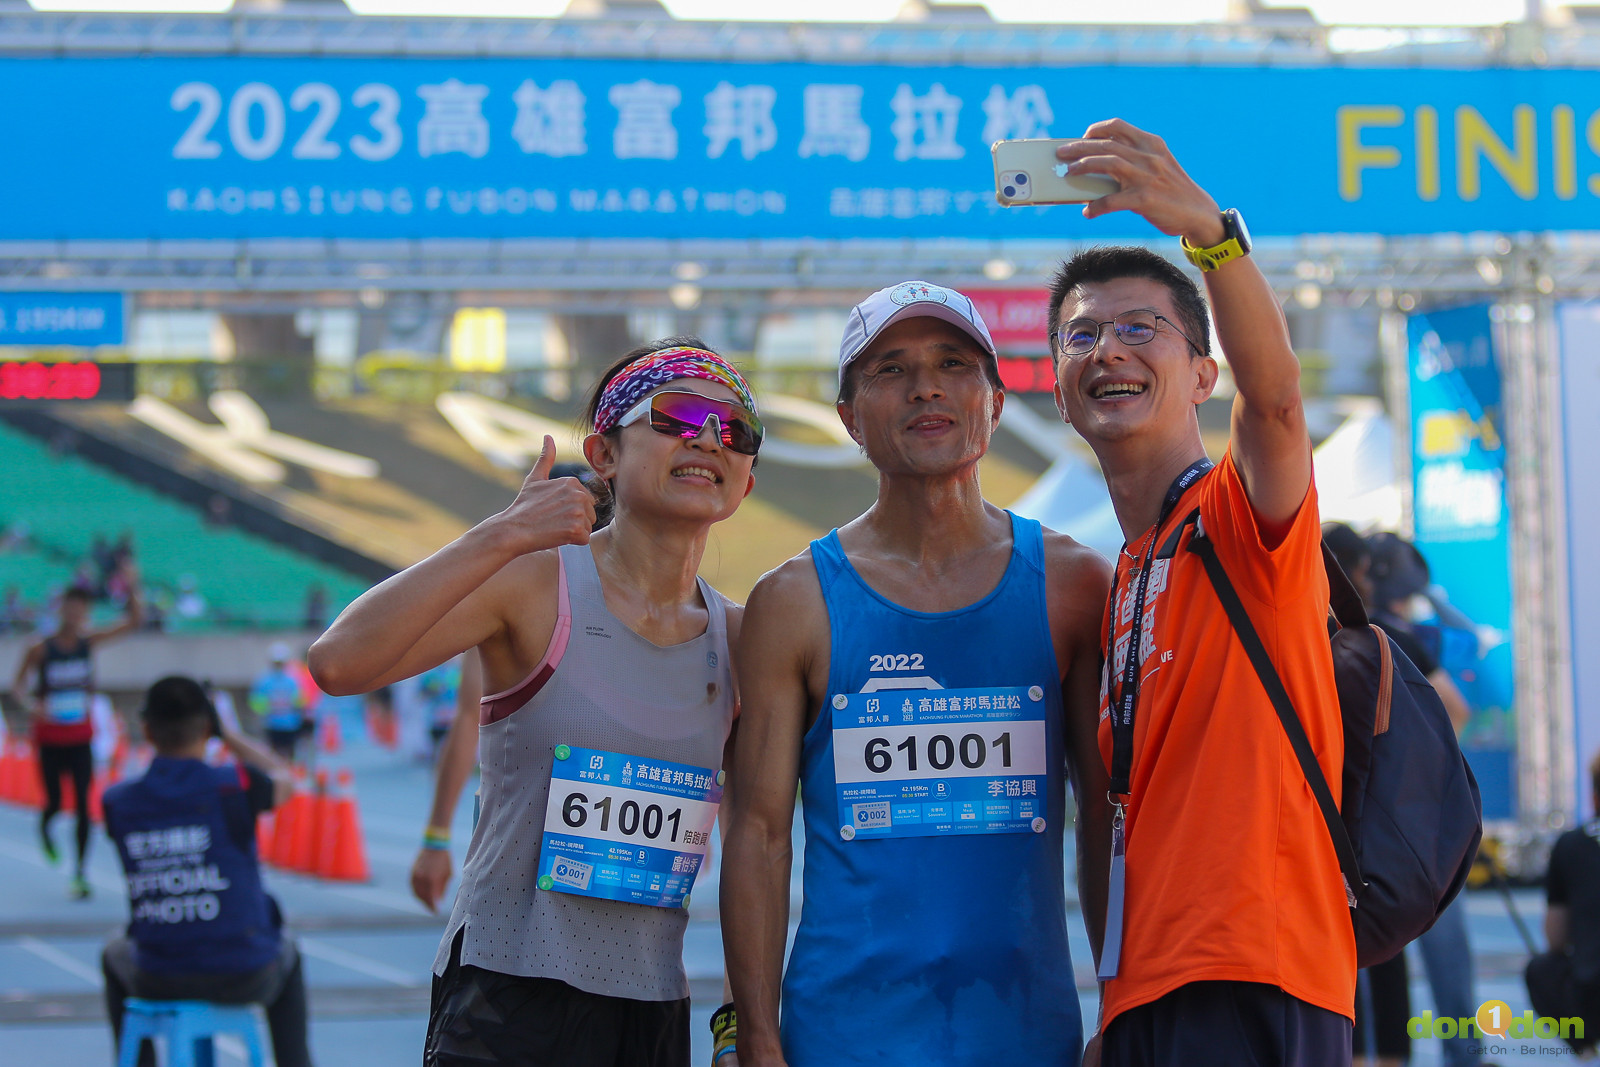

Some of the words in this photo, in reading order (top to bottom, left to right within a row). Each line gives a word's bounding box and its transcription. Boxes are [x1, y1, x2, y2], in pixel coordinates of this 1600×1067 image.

[869, 654, 924, 672] 2022
[918, 695, 1021, 713] 高雄富邦馬拉松
[858, 715, 890, 724] 富邦人壽
[864, 732, 1013, 774] 61001
[579, 770, 610, 782] 富邦人壽
[636, 764, 712, 790] 高雄富邦馬拉松
[938, 784, 945, 792] B
[988, 780, 1036, 797] 李協興
[562, 792, 682, 842] 61001
[870, 810, 886, 819] 002
[683, 830, 708, 846] 陪跑員
[639, 851, 645, 859] B
[569, 869, 585, 880] 001
